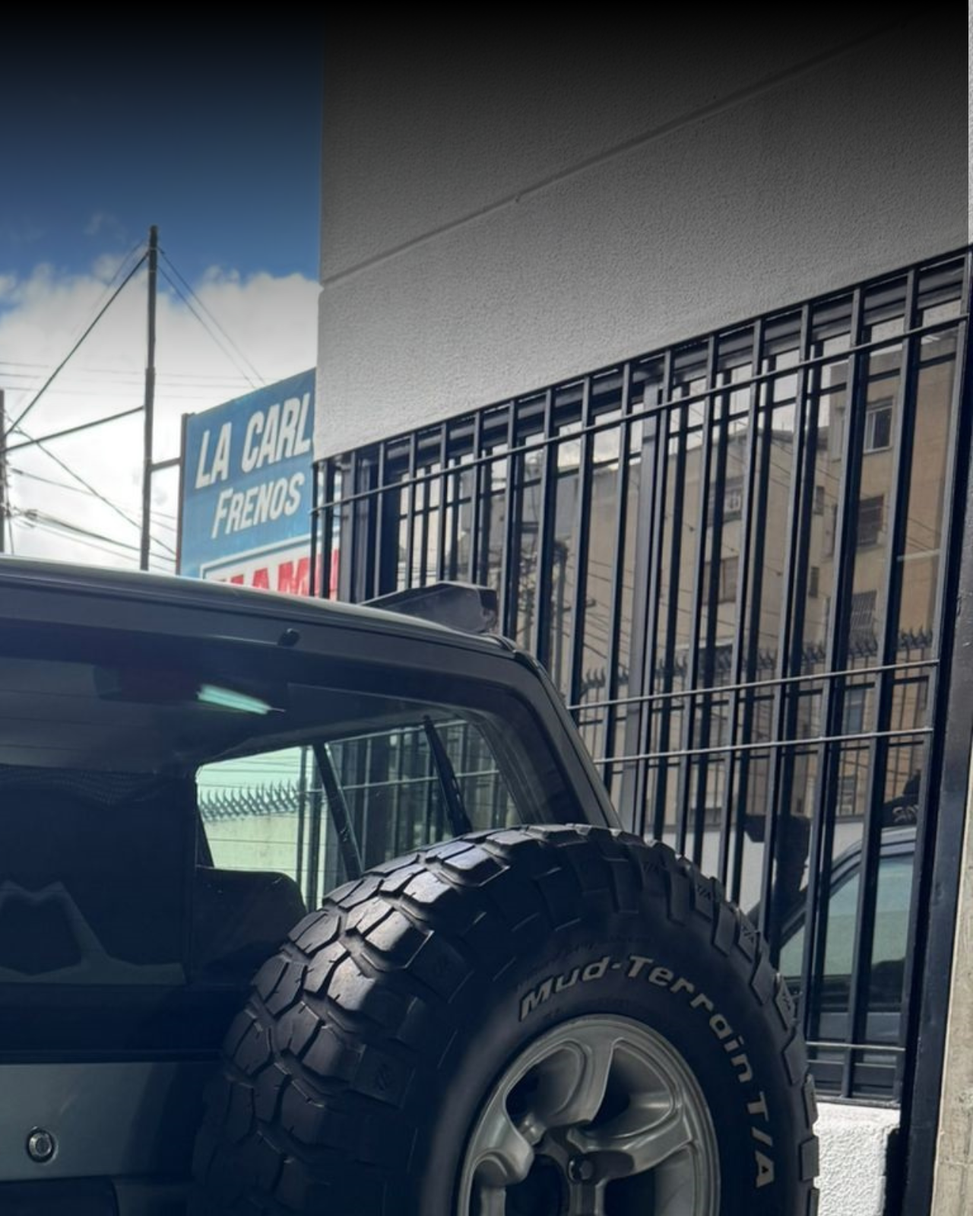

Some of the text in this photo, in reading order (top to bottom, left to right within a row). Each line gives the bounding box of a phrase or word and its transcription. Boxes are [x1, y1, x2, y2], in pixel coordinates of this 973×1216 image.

[195, 421, 232, 489] LA
[211, 471, 305, 539] FRENOS
[519, 954, 776, 1189] Mud-Terrain T/A
